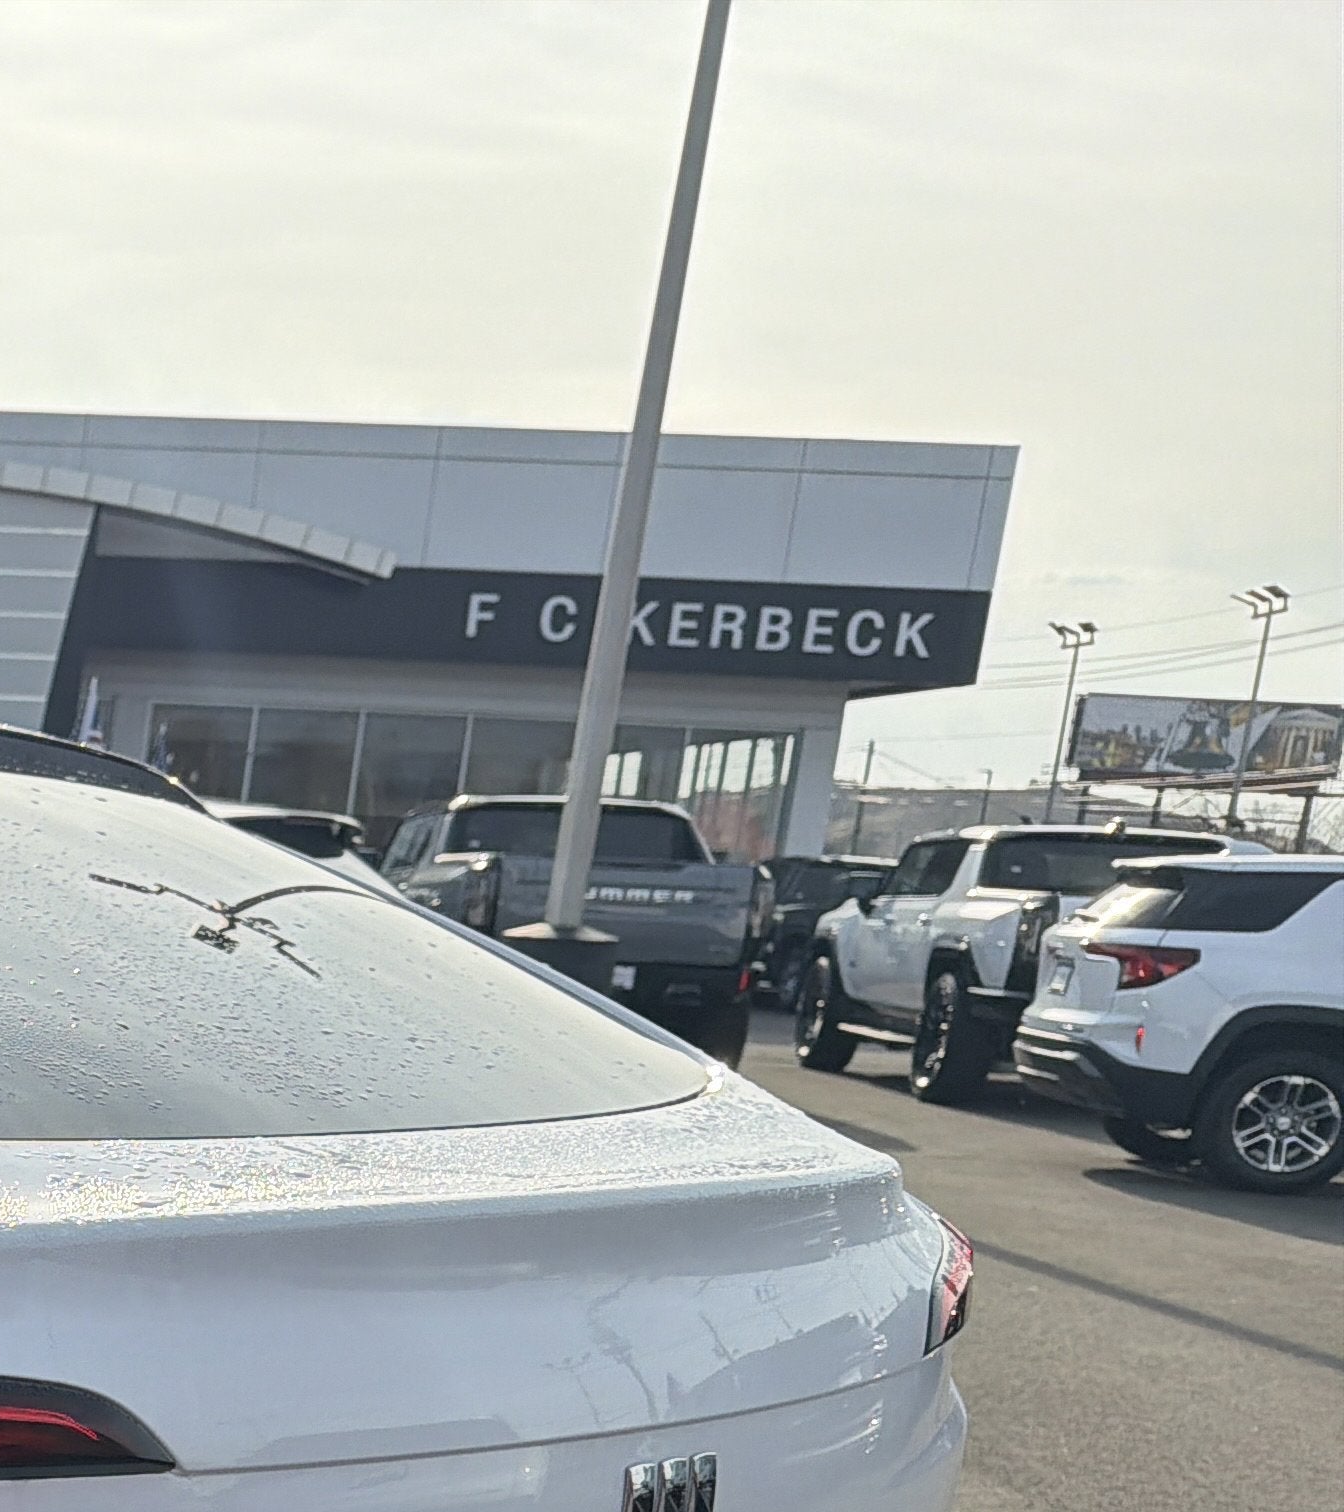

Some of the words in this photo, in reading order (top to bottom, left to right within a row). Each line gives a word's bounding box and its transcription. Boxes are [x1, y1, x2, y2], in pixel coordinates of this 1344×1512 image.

[465, 592, 501, 638] F
[539, 595, 578, 643] C
[629, 600, 935, 659] KERBECK
[584, 886, 694, 904] UMMER
